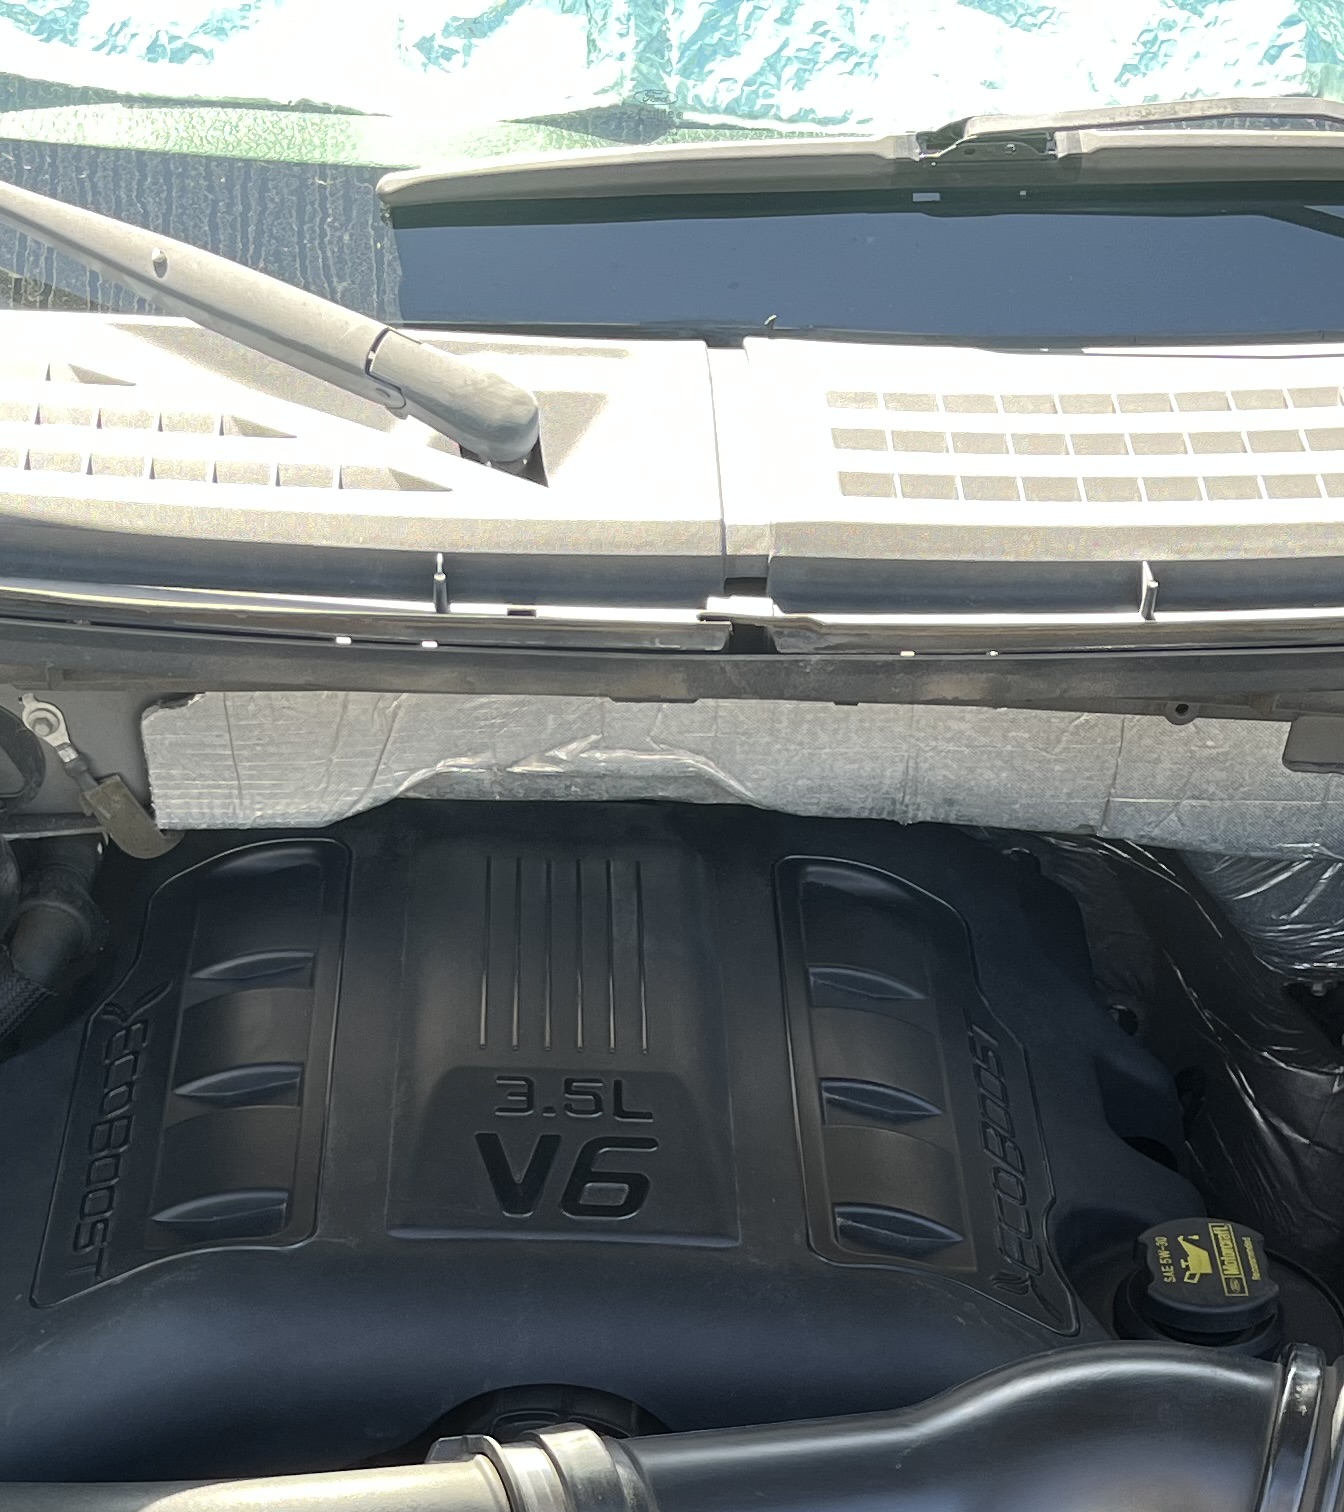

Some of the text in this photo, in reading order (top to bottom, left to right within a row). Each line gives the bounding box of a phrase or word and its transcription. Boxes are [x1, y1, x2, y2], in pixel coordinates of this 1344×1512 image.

[494, 1075, 654, 1123] 3.5L
[474, 1133, 661, 1220] V6
[1160, 1265, 1176, 1283] SAE
[1212, 1225, 1241, 1275] Motorcraft
